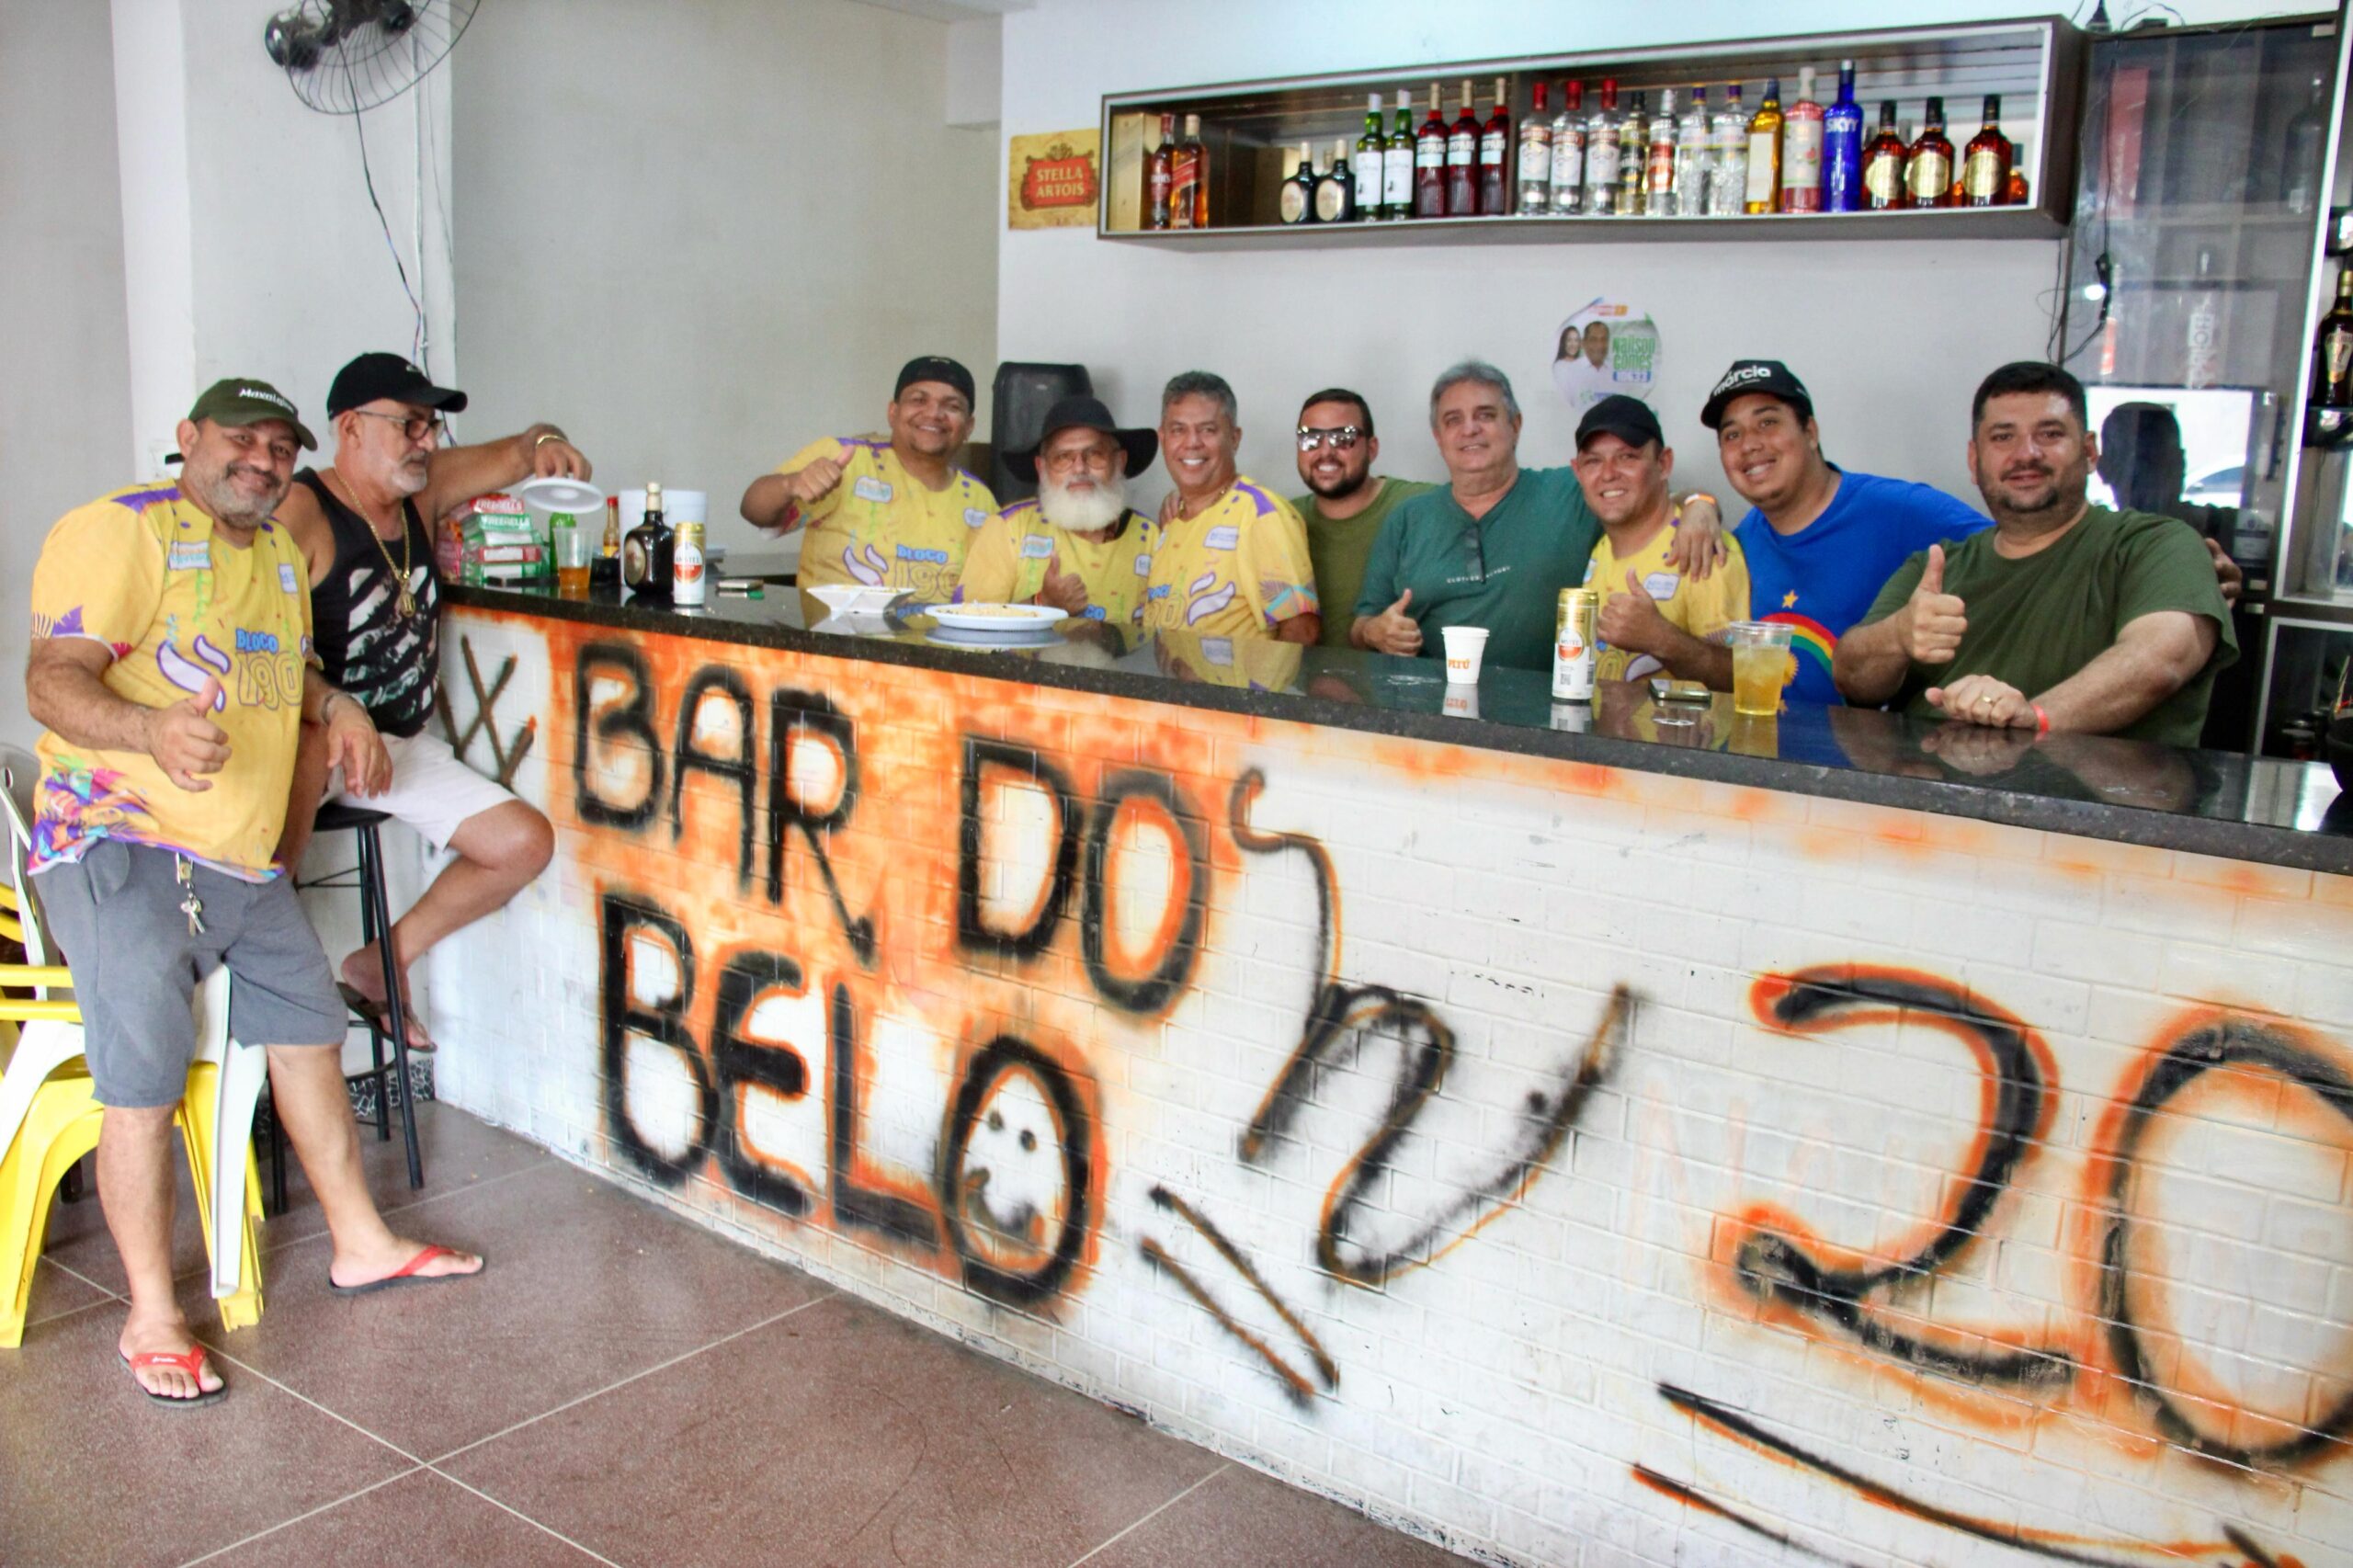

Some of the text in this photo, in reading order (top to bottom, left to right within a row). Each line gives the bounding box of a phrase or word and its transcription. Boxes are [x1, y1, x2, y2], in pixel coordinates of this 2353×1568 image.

[1824, 117, 1859, 132] SKYY
[1036, 165, 1084, 183] STELLA
[1036, 184, 1085, 199] ARTOIS
[235, 627, 279, 655] BLOCO
[235, 650, 303, 711] 190
[575, 641, 876, 967] BAR
[961, 737, 1210, 1014] DO
[600, 892, 1094, 1307] BELO
